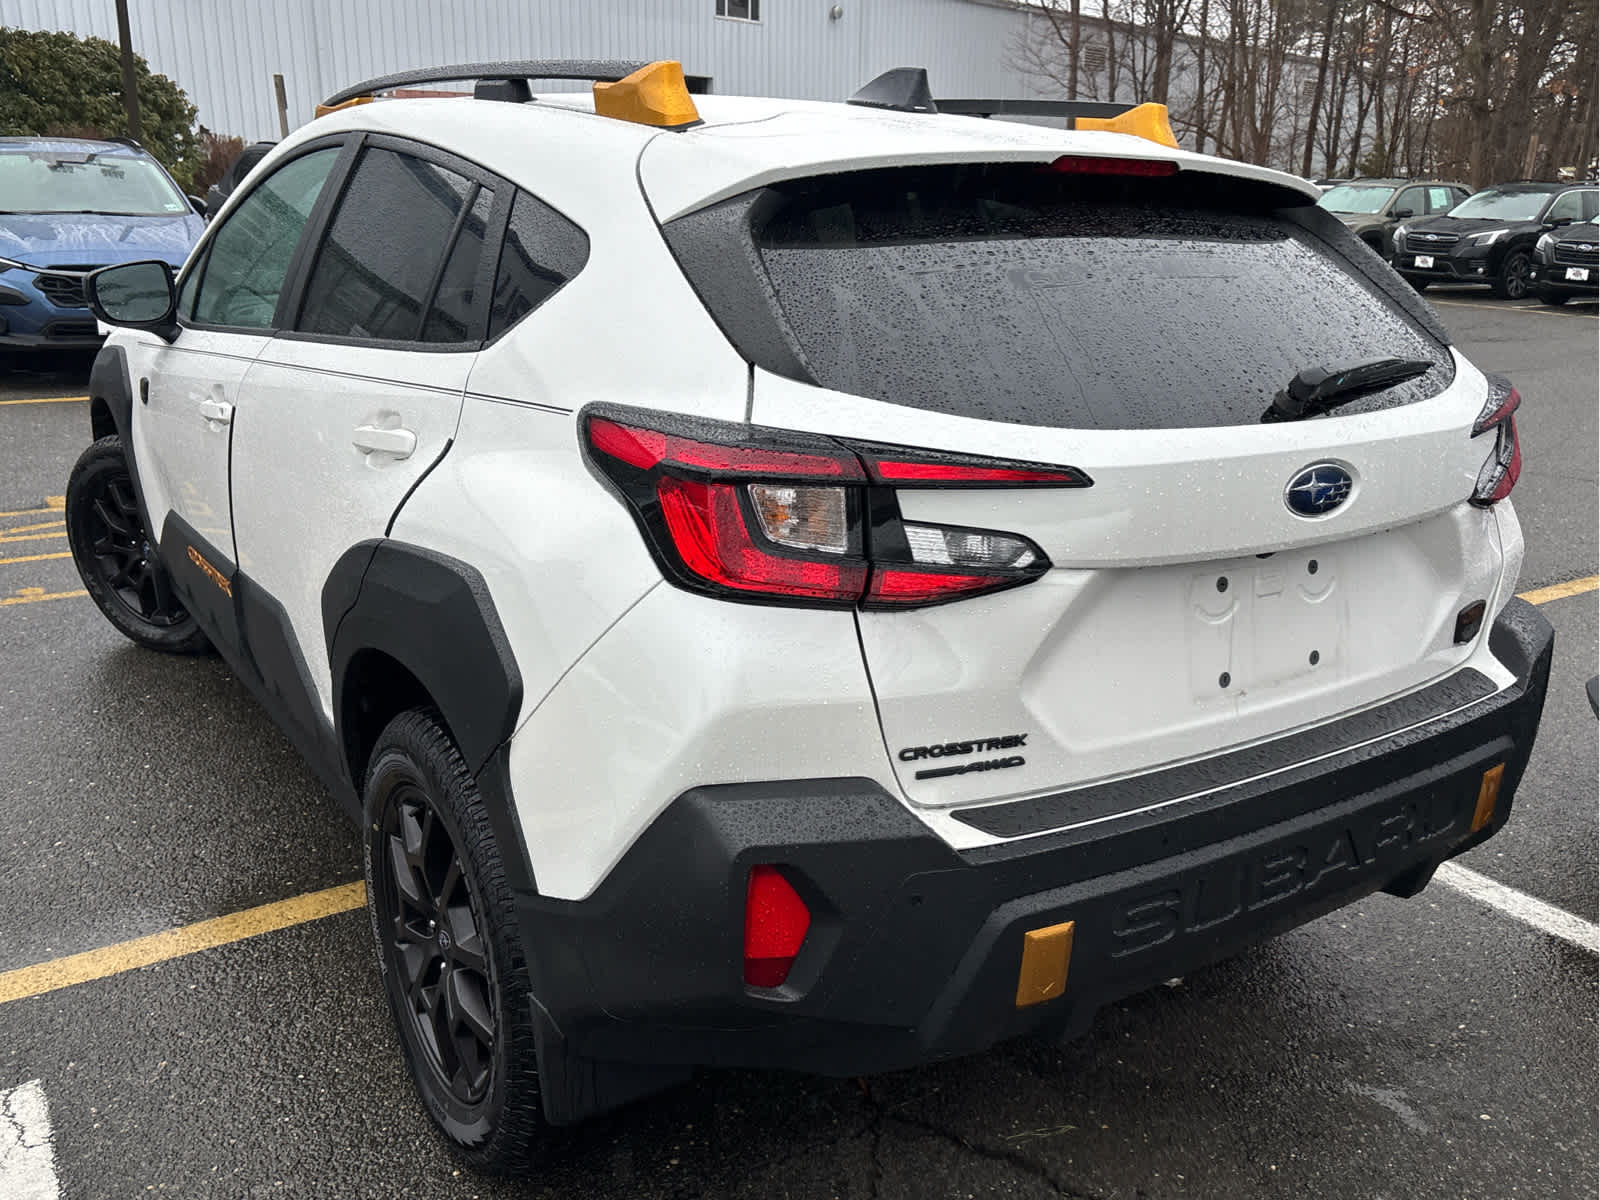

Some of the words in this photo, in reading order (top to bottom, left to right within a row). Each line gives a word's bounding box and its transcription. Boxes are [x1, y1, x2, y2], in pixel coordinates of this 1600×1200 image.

[898, 733, 1028, 762] CROSSTREK
[960, 755, 1026, 775] AWD
[1111, 796, 1459, 959] SUBARU
